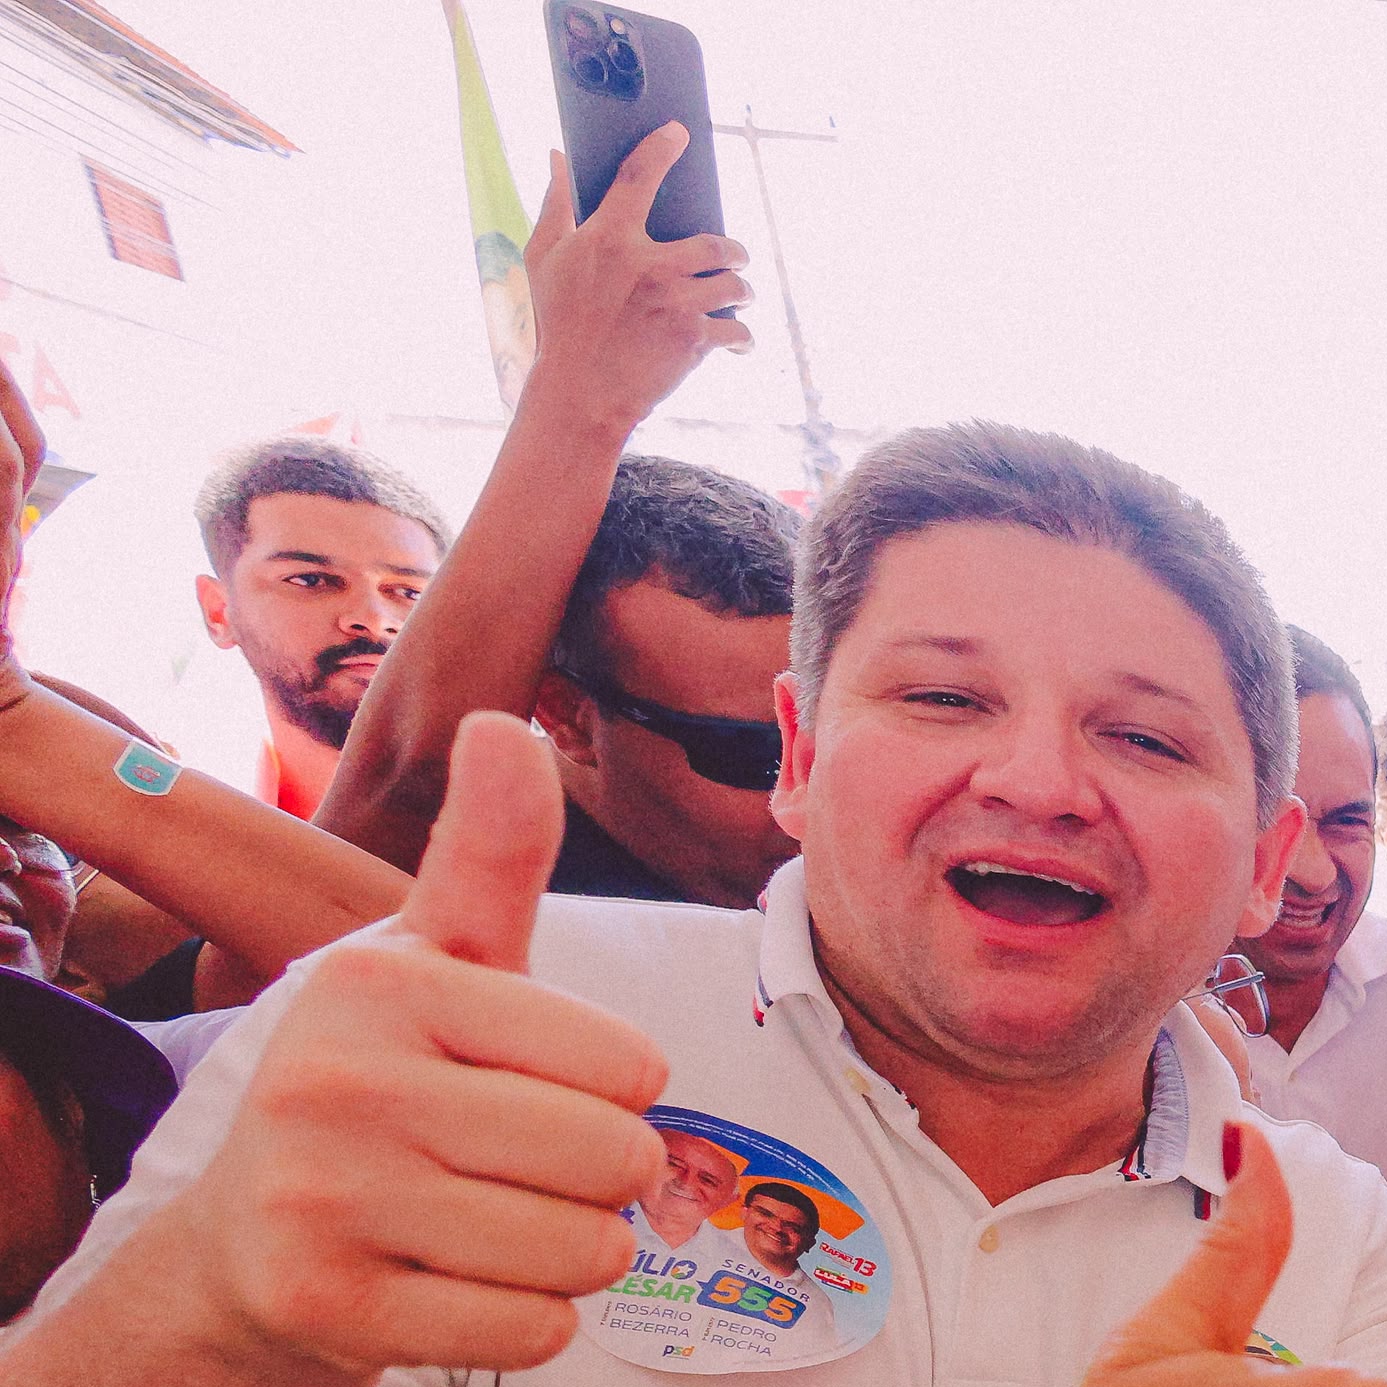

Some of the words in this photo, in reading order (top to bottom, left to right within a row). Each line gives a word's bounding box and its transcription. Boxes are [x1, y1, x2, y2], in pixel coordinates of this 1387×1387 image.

[853, 1257, 877, 1277] 13
[722, 1258, 811, 1302] SENADOR
[711, 1277, 804, 1322] 555
[614, 1301, 693, 1322] ROSÁRIO
[608, 1318, 691, 1338] BEZERRA
[715, 1319, 778, 1343] PEDRO
[662, 1344, 696, 1357] psd
[710, 1334, 772, 1357] ROCHA
